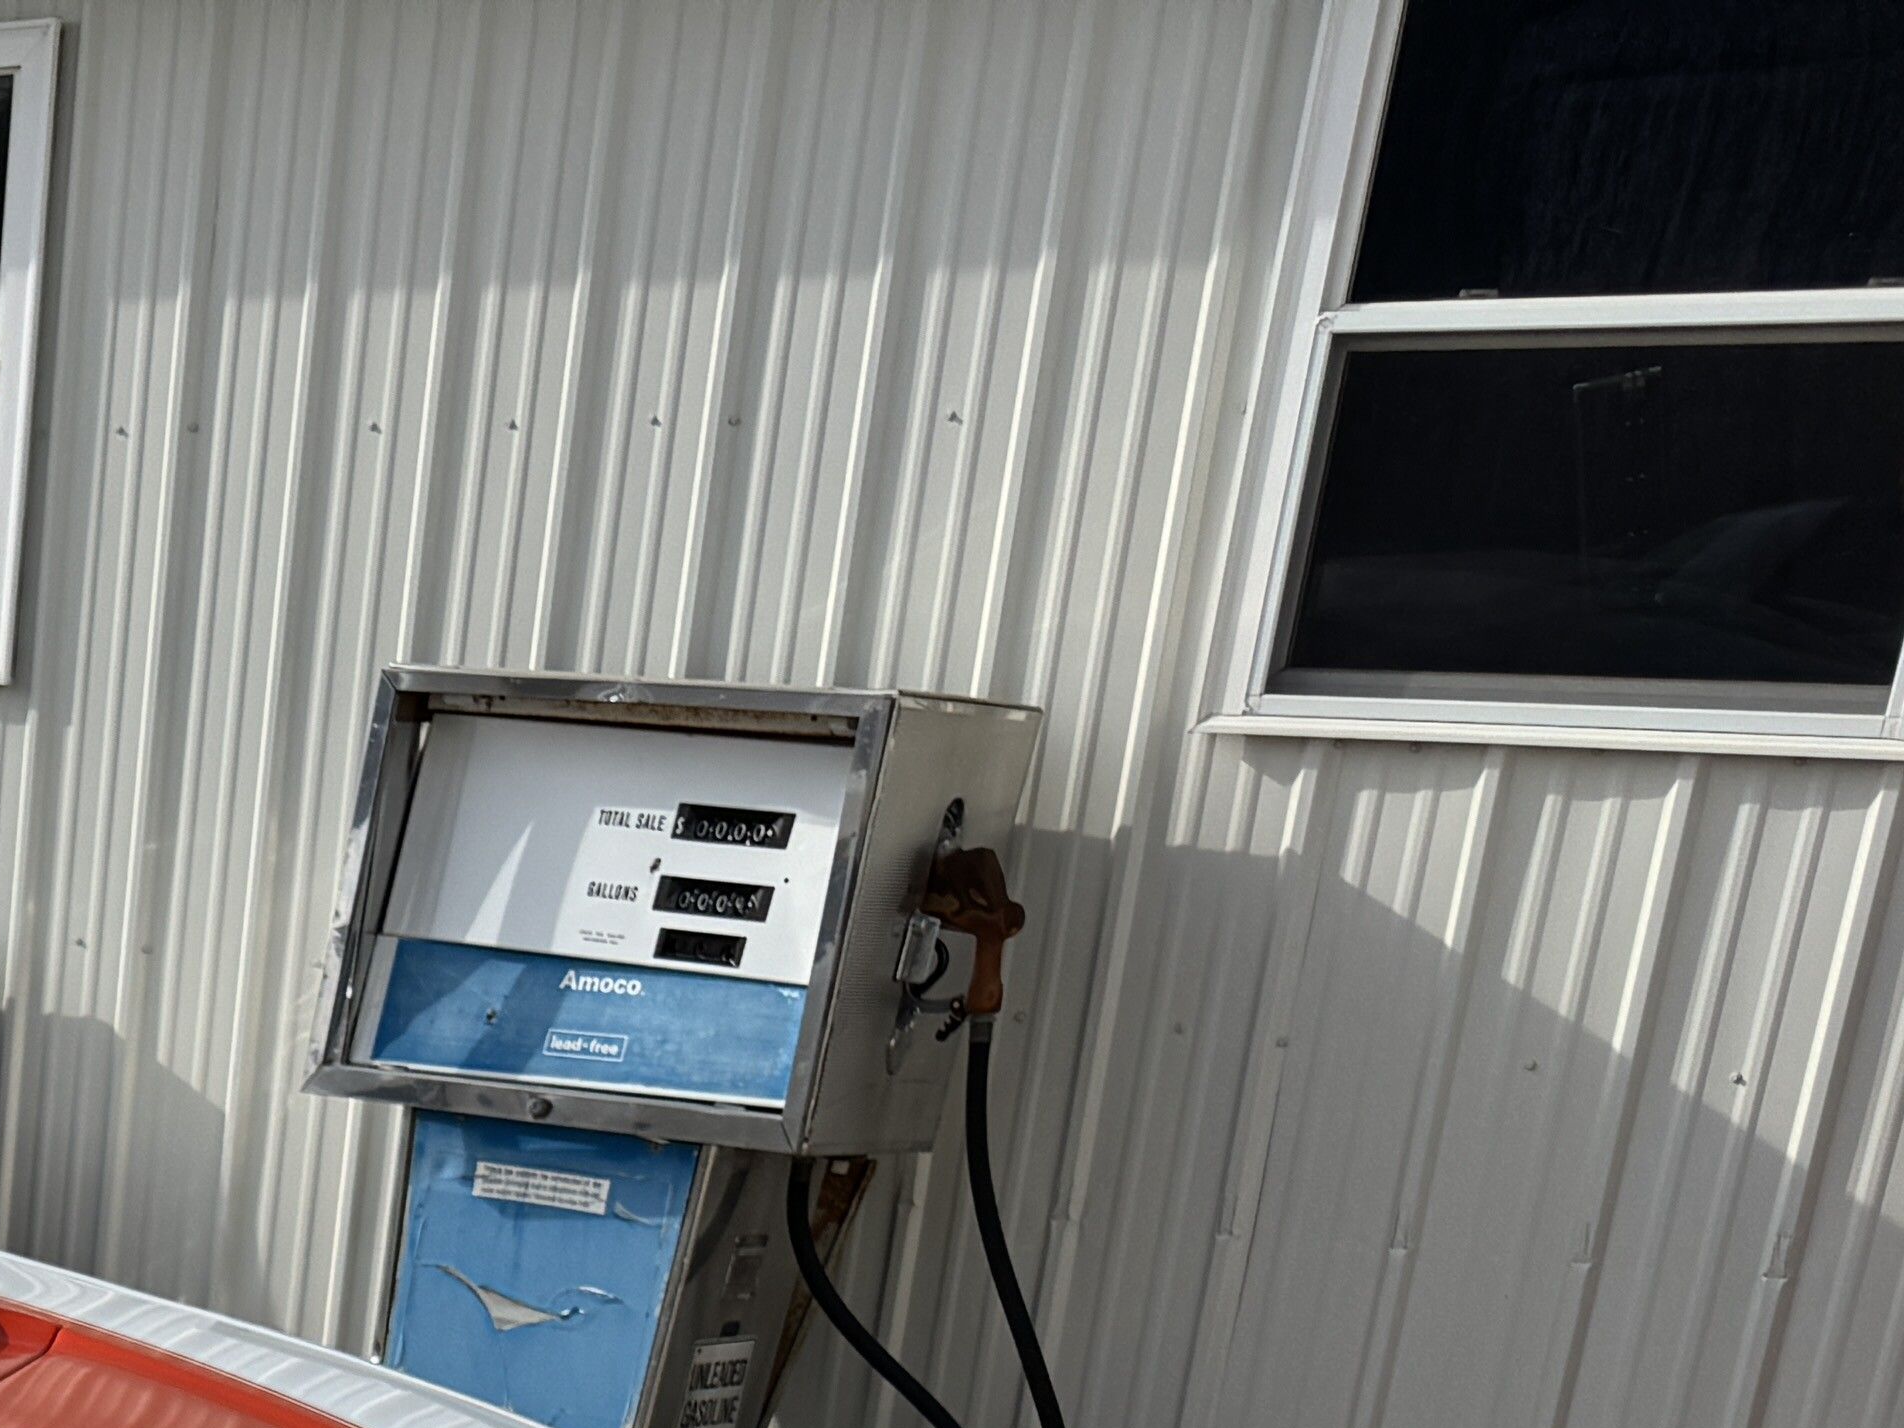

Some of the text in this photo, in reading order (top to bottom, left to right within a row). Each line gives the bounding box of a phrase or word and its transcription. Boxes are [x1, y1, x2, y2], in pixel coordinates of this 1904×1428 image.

[598, 809, 630, 828] TOTAL
[635, 812, 667, 832] SALE
[587, 881, 638, 902] GALLONS
[549, 1034, 620, 1056] lead-free
[689, 1358, 748, 1392] UNLEADED
[680, 1395, 740, 1428] GASOLINE
